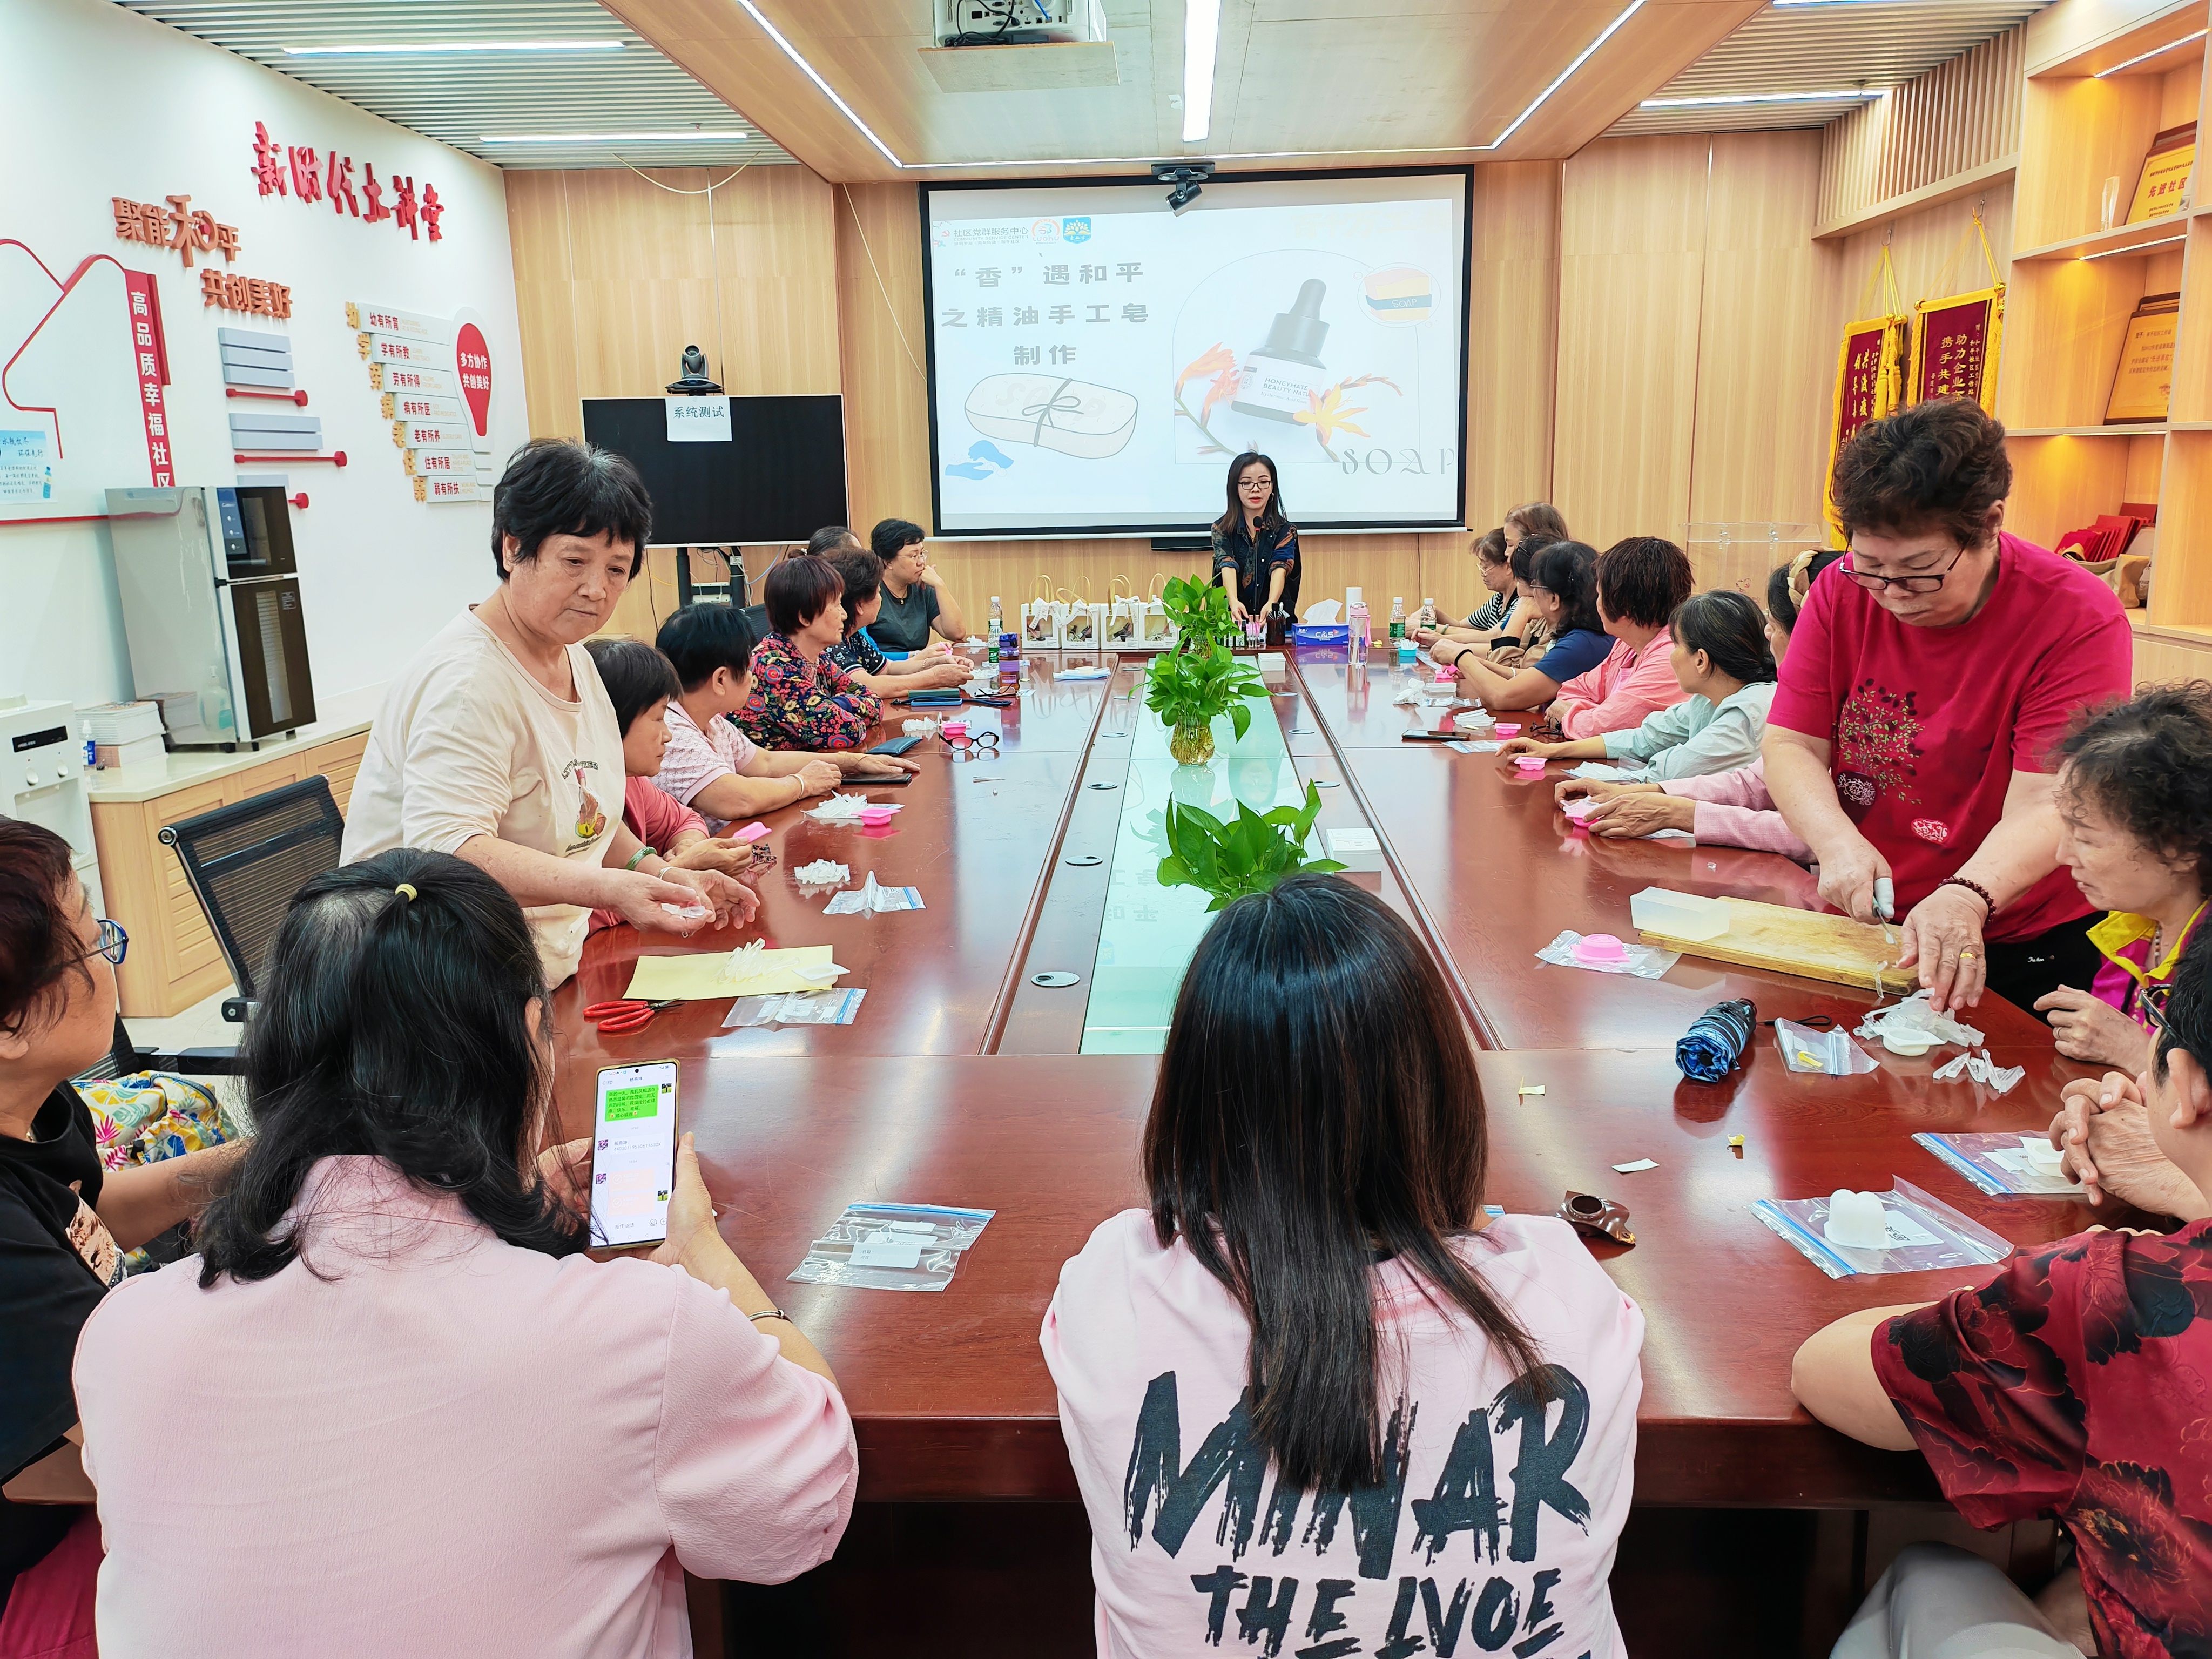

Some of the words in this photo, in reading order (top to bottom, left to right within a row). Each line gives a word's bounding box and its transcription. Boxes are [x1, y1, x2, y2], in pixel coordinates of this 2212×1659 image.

[2148, 177, 2188, 199] 先进社区
[112, 194, 241, 267] 聚能和平
[953, 226, 1029, 237] 社区党群服务中心
[200, 269, 293, 318] 共创美好
[1392, 299, 1417, 308] SOAP
[370, 312, 399, 331] 幼有所育
[941, 303, 1148, 327] 之精油手工皂
[381, 342, 410, 359] 学有所教
[1014, 345, 1077, 365] 制作
[460, 352, 488, 370] 多方协作
[1936, 336, 1954, 395] 携手共建
[393, 372, 420, 388] 劳有所得
[462, 373, 489, 390] 共创美好
[1263, 383, 1291, 393] BEAUTY
[1265, 377, 1308, 391] HONEYMATE
[131, 291, 171, 487] 高品质幸福社区
[404, 401, 431, 415] 病有所医
[673, 406, 724, 419] 系统测试
[414, 429, 440, 443] 老有所养
[425, 456, 450, 470] 住有所居
[1342, 448, 1455, 475] SOAP
[434, 482, 460, 495] 弱有所扶
[1190, 1565, 1362, 1659] THE
